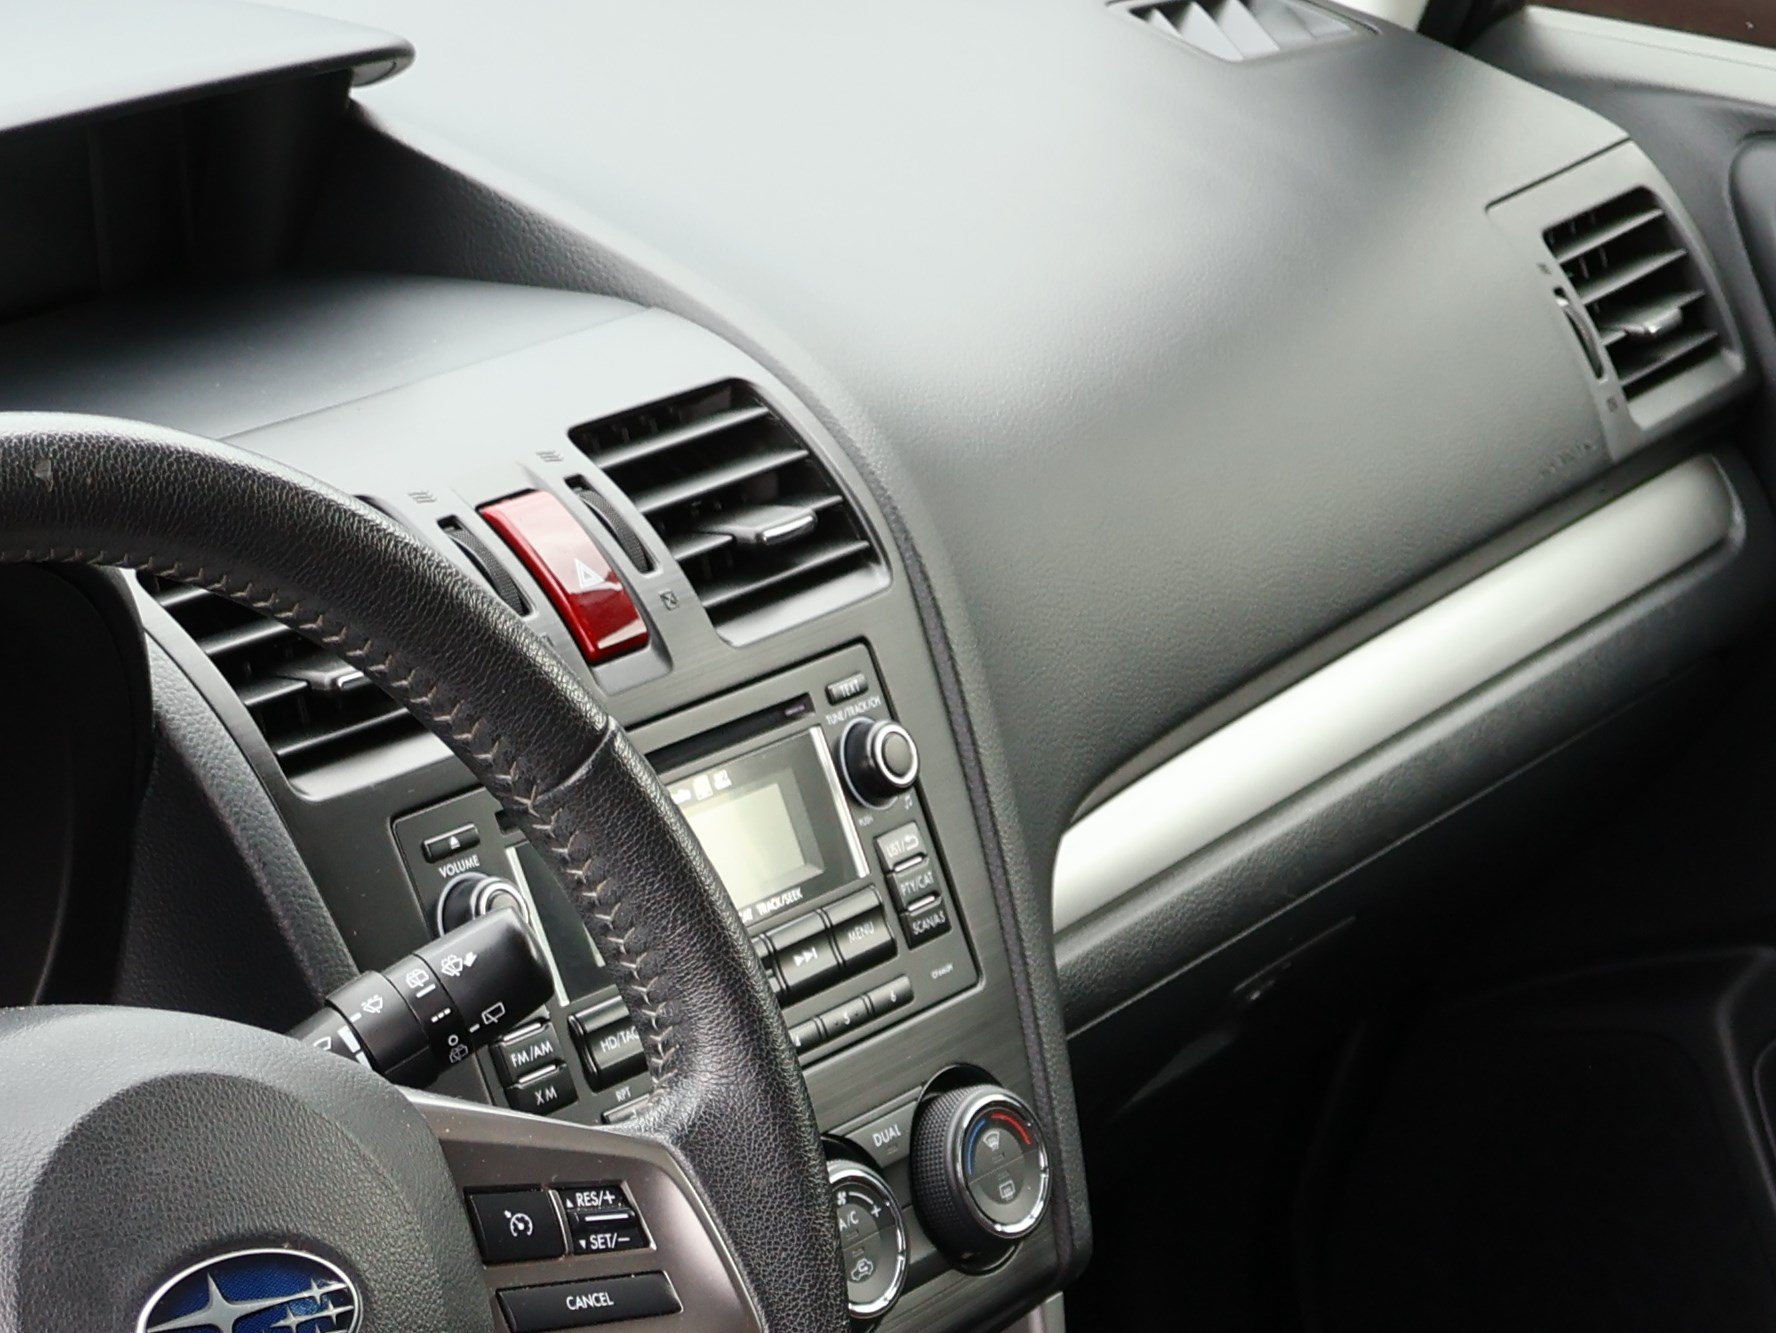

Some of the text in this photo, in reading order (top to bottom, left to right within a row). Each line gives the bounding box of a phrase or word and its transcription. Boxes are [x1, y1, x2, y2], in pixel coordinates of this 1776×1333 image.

[438, 854, 480, 878] VOLUME
[900, 871, 935, 897] PTY/CAT
[756, 887, 803, 916] TRACK/SEEK
[847, 922, 875, 944] MENU
[511, 1040, 554, 1068] FM/AM
[614, 1086, 631, 1102] RPT
[872, 1124, 902, 1148] DUAL
[566, 1292, 615, 1312] CANCEL
